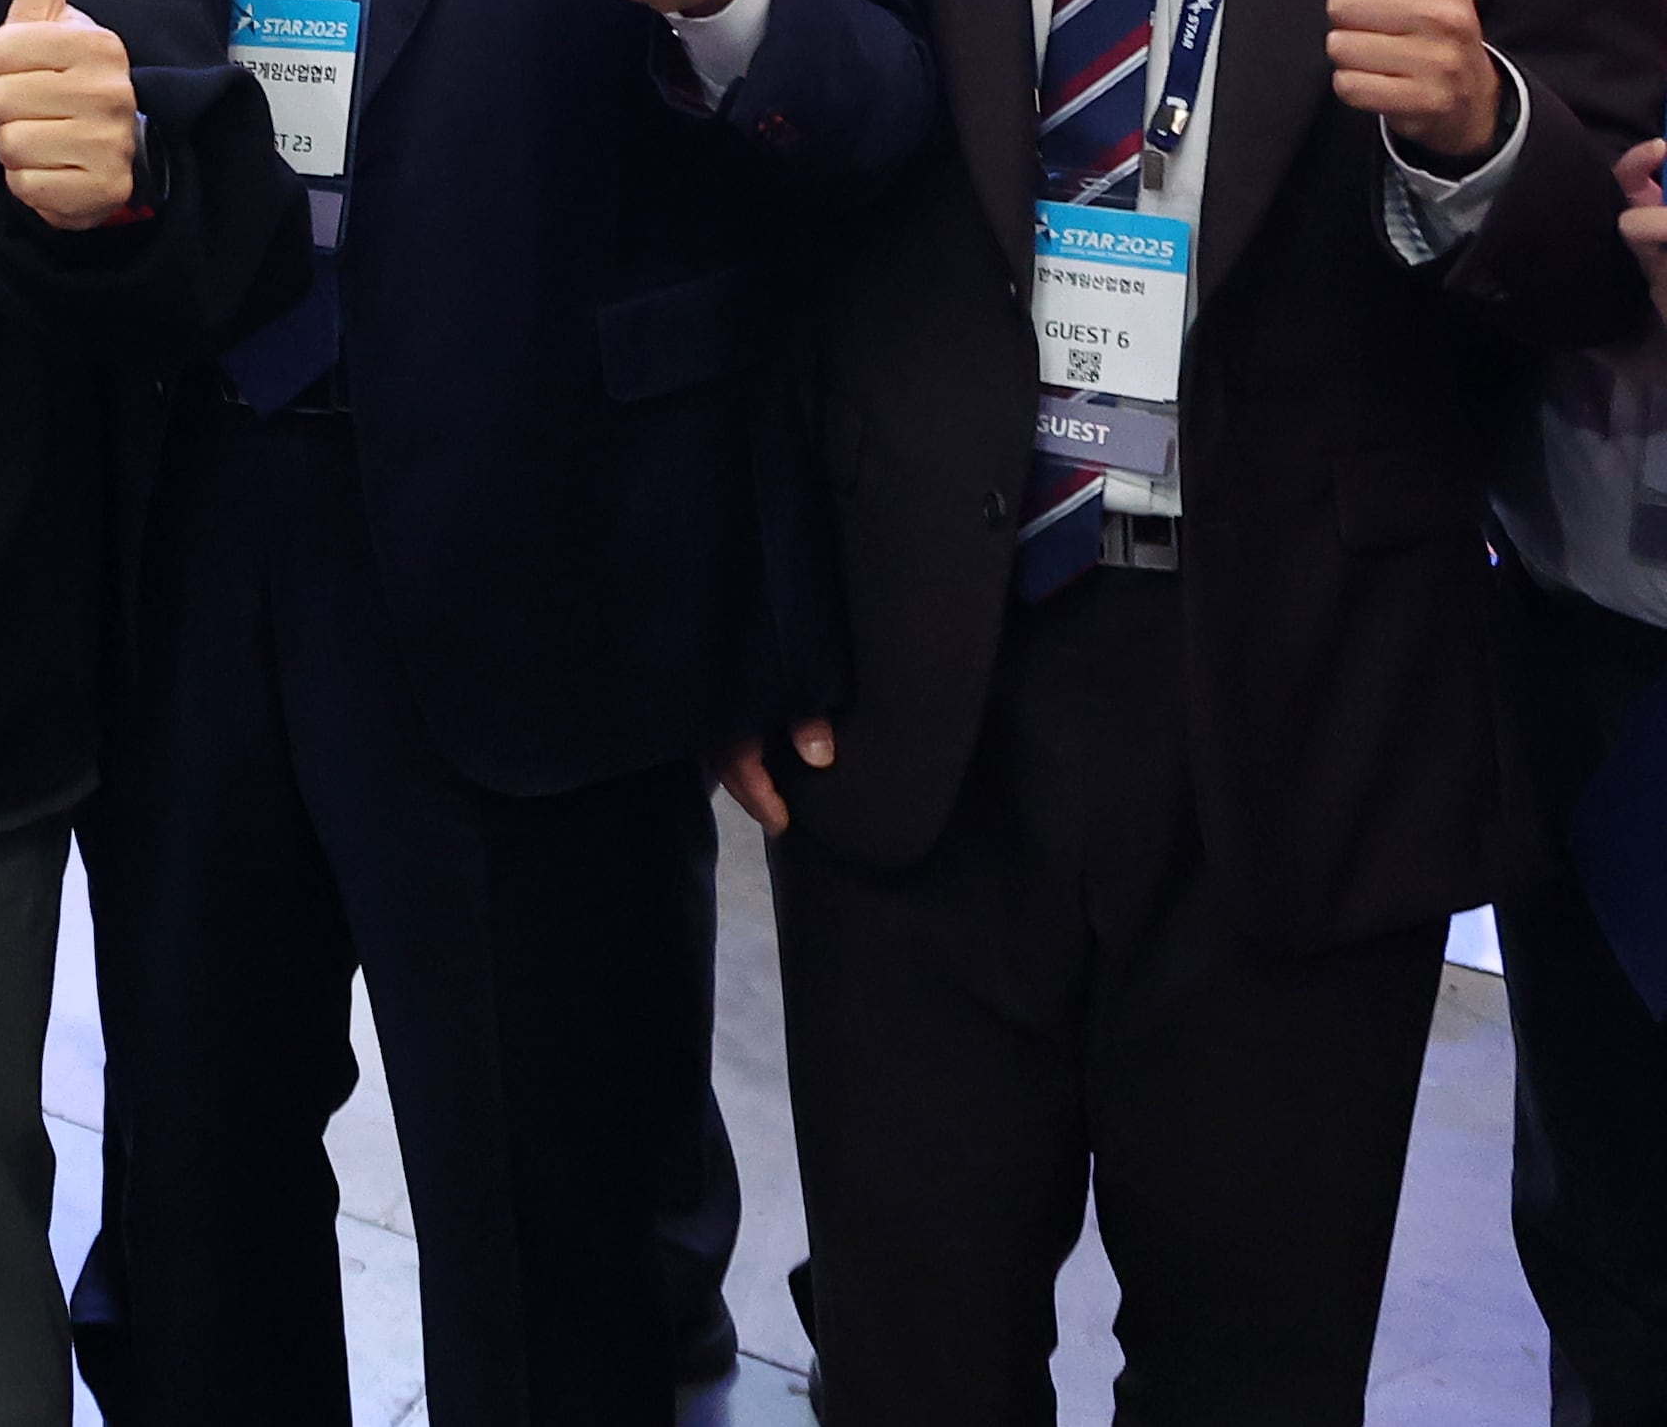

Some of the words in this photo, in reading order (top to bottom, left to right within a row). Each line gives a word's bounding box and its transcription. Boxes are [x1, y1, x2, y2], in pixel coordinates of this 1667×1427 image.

[292, 134, 313, 153] 23
[1044, 320, 1111, 345] GUEST
[1117, 330, 1130, 349] 6
[1037, 414, 1110, 446] GUEST
